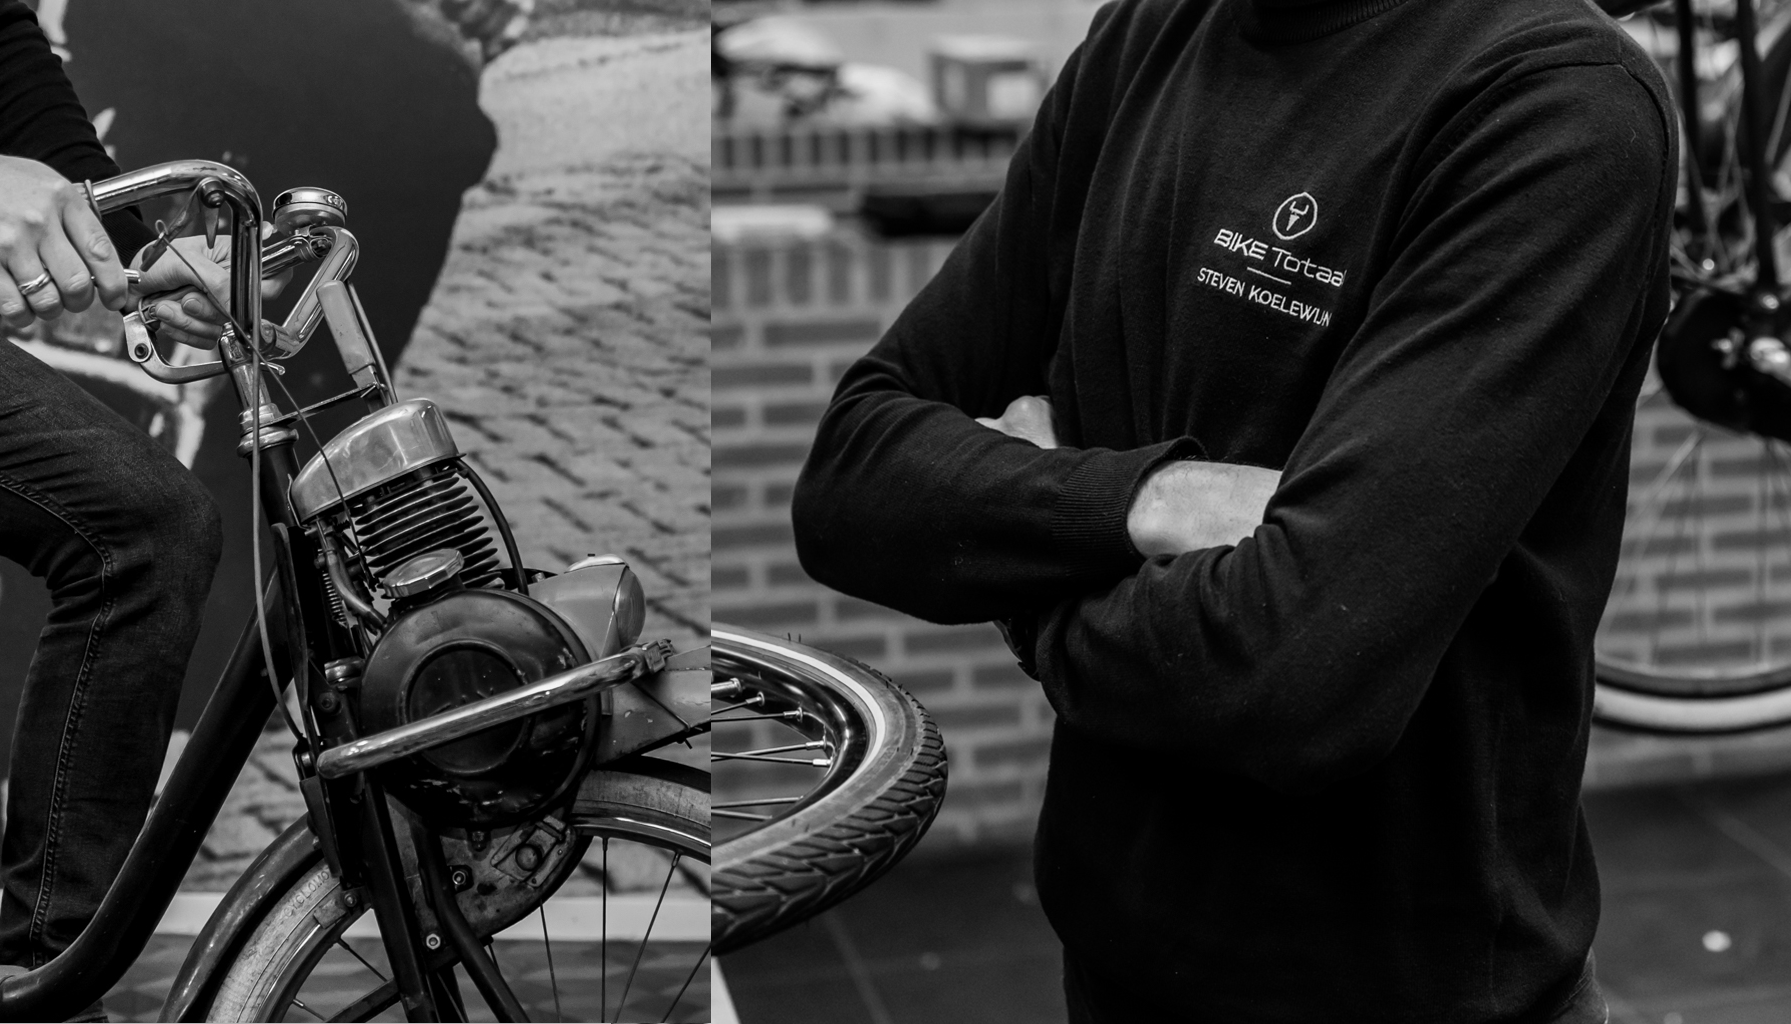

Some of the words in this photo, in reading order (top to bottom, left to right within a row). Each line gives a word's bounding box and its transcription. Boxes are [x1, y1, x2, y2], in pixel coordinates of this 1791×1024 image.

[1214, 228, 1269, 261] BIKE
[1271, 246, 1347, 287] Totaal
[1197, 267, 1246, 297] STEVEN
[1248, 284, 1333, 327] KOELEWIJN
